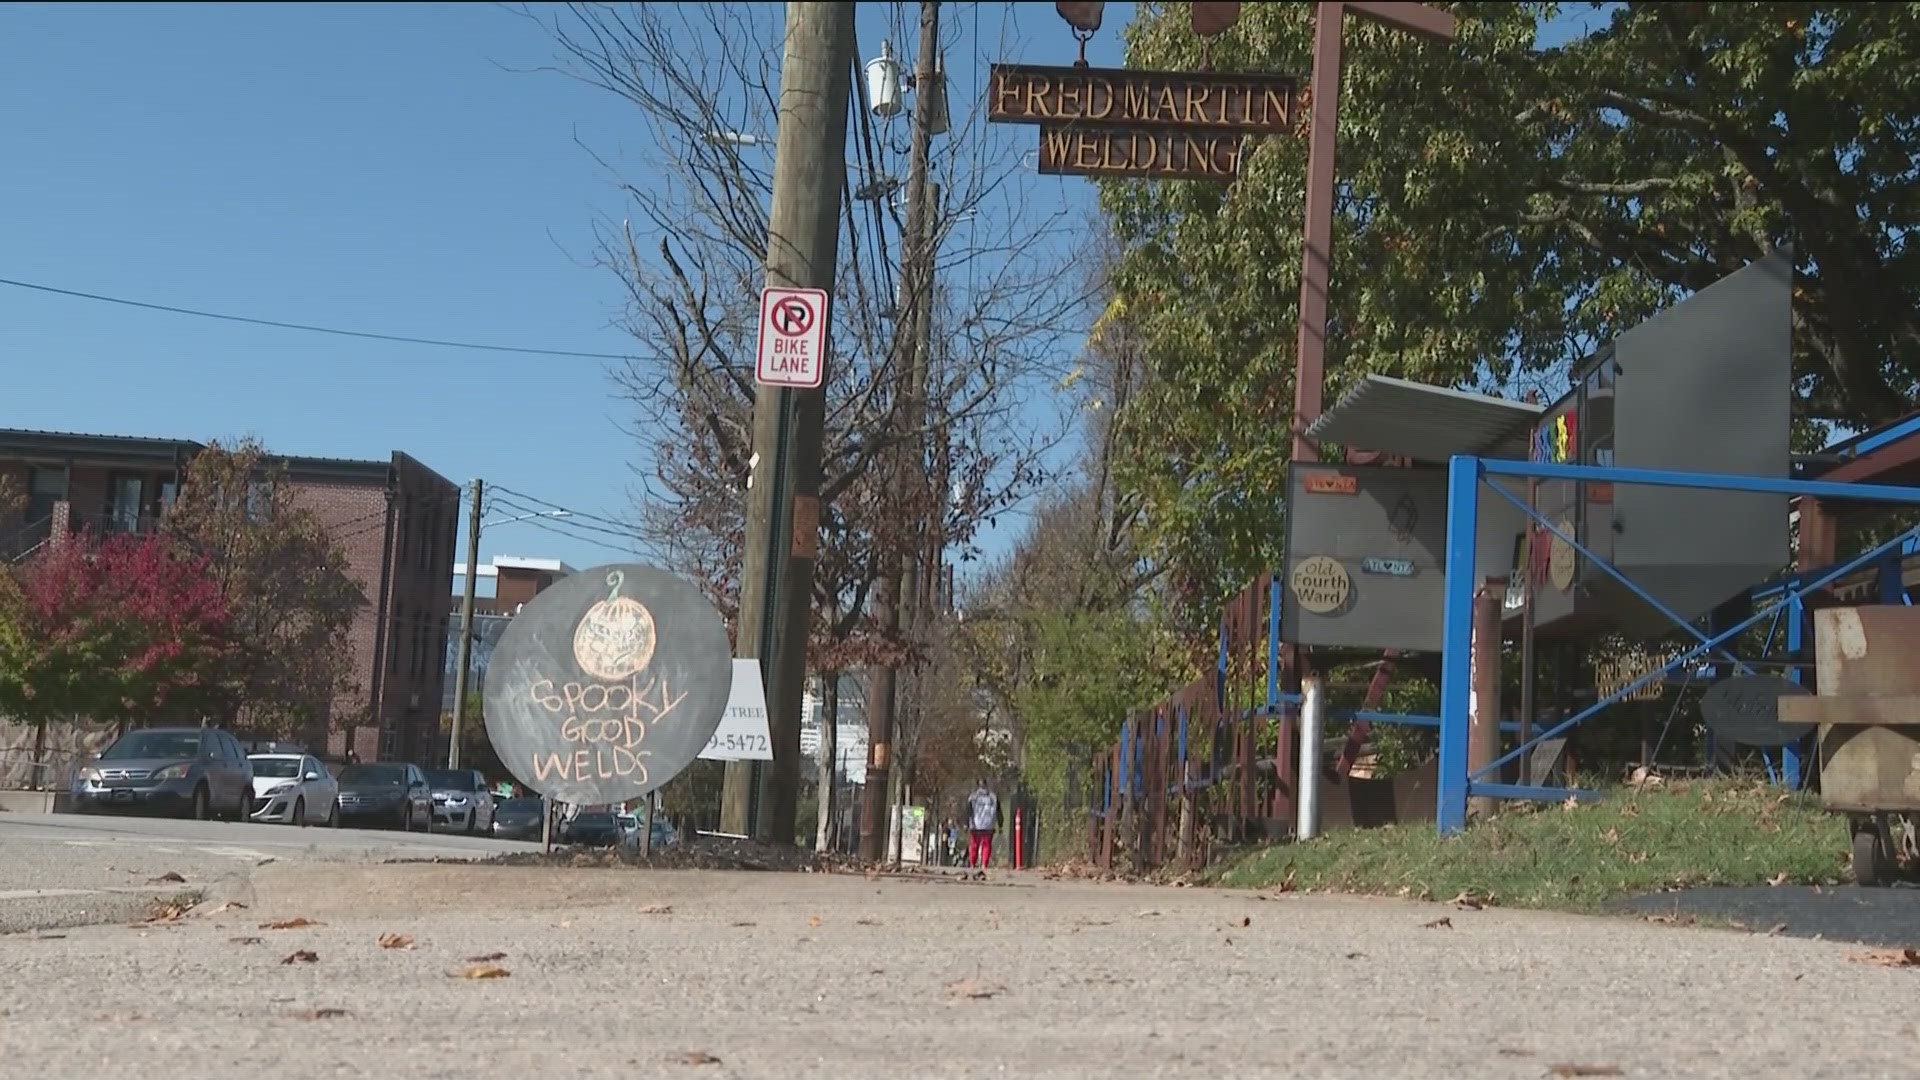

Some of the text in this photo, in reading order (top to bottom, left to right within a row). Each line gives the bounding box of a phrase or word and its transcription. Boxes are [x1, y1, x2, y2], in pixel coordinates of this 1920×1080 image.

[993, 72, 1289, 126] FRED MARTIN
[1045, 128, 1237, 175] WELDING
[774, 339, 808, 355] BIKE
[770, 356, 809, 373] LANE
[1305, 562, 1336, 576] Old
[1293, 573, 1346, 590] Fourth
[1298, 588, 1340, 604] Ward
[531, 675, 688, 724] SPOOKY
[729, 706, 765, 718] TREE
[561, 715, 645, 748] GOOD
[533, 746, 652, 785] WELDS
